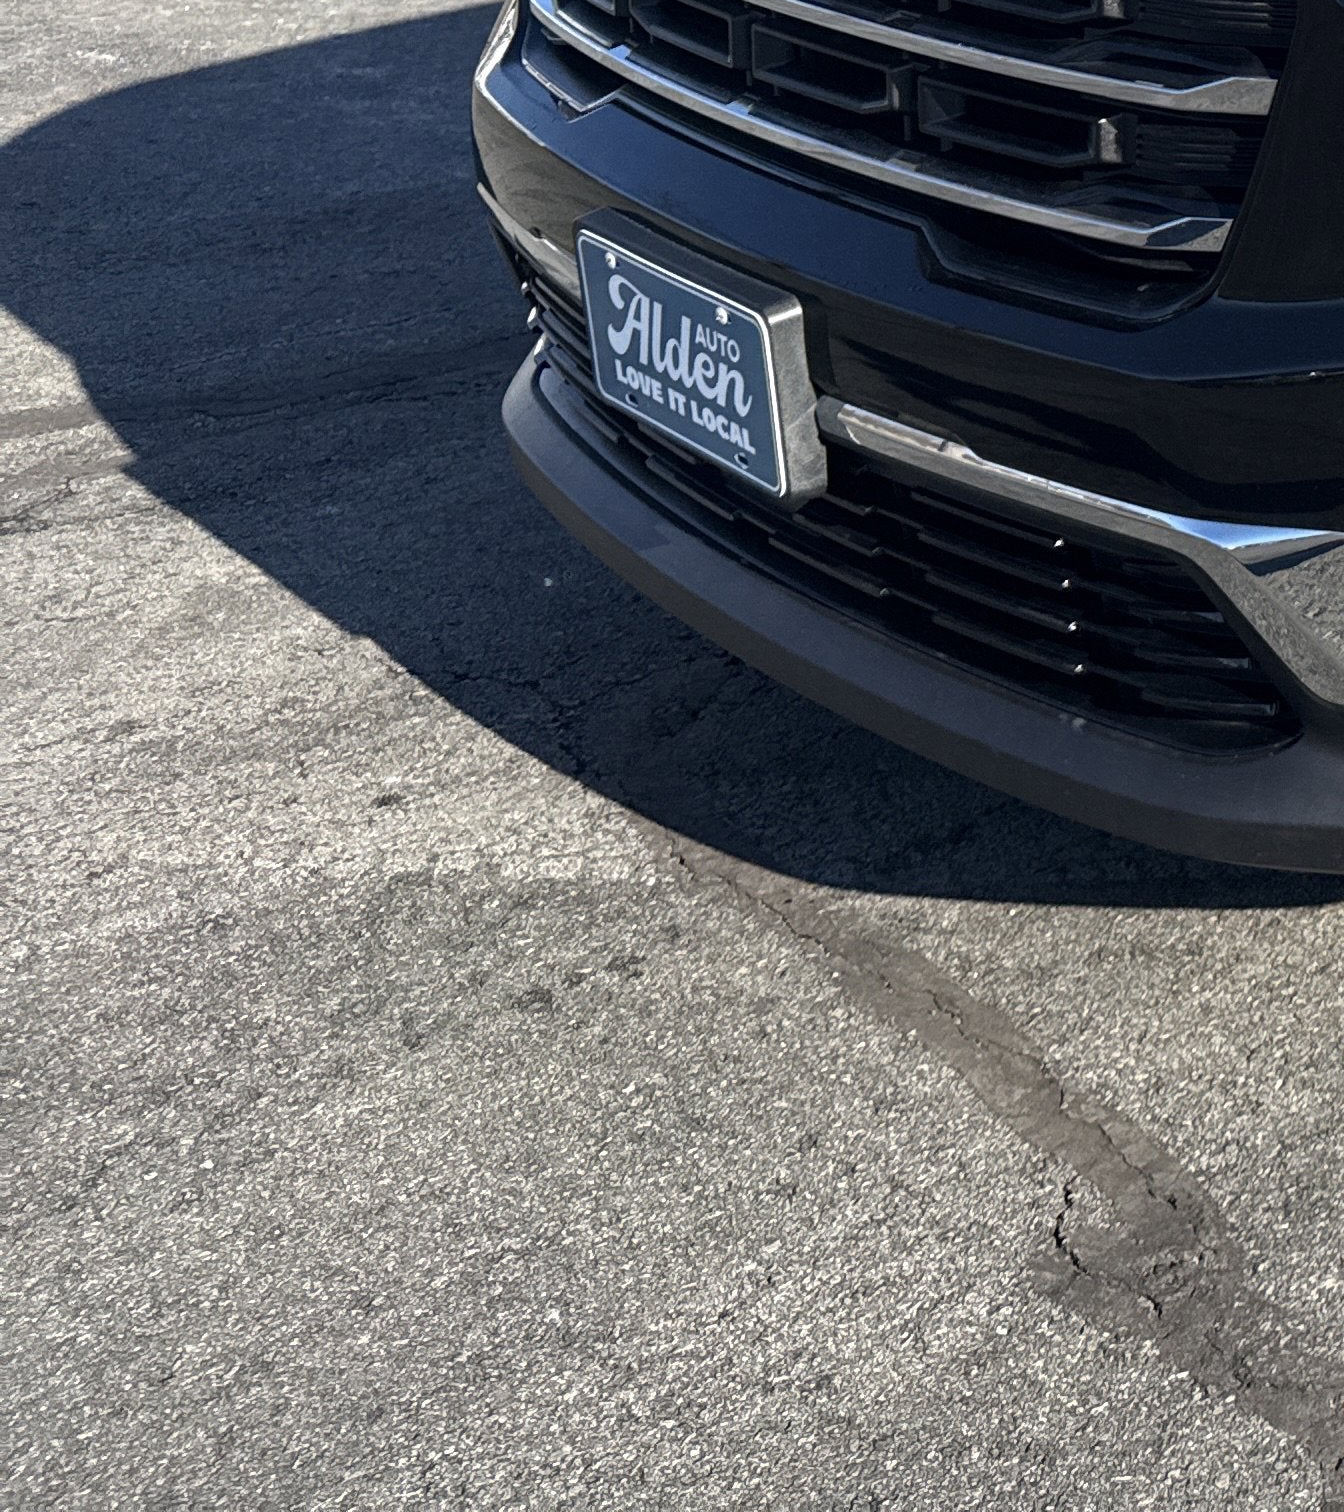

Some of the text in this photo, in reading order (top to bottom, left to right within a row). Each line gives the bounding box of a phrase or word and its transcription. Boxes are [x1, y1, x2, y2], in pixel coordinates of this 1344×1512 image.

[608, 273, 752, 418] Alden
[695, 323, 741, 363] AUTO
[614, 358, 757, 456] LOVE IT LOCAL
